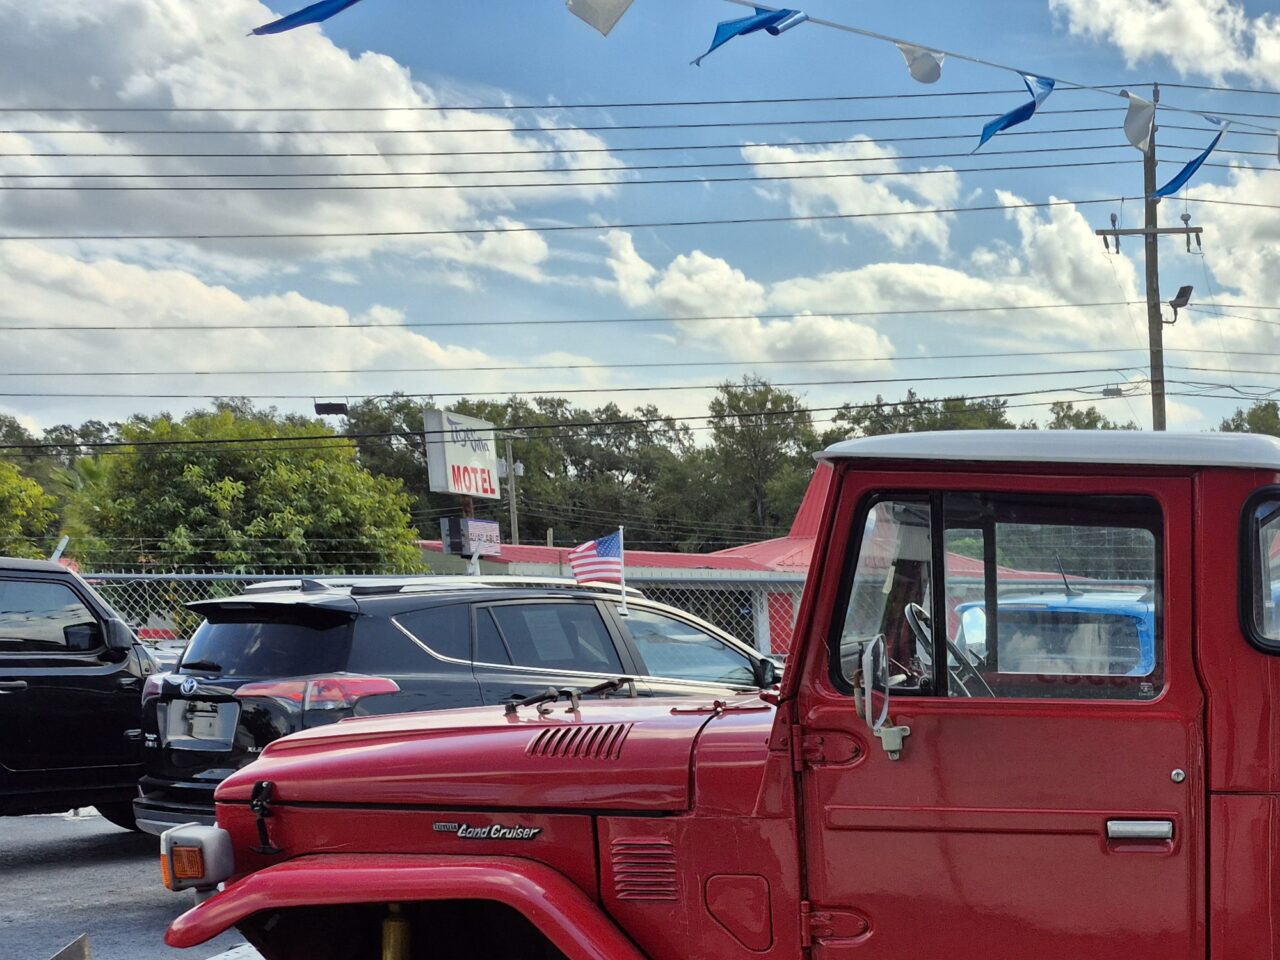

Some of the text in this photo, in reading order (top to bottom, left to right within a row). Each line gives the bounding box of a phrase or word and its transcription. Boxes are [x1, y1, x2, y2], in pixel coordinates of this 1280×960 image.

[447, 416, 475, 447] Tiger
[470, 438, 490, 453] Villa
[451, 464, 496, 495] MOTEL
[457, 823, 540, 838] Land Cruiser
